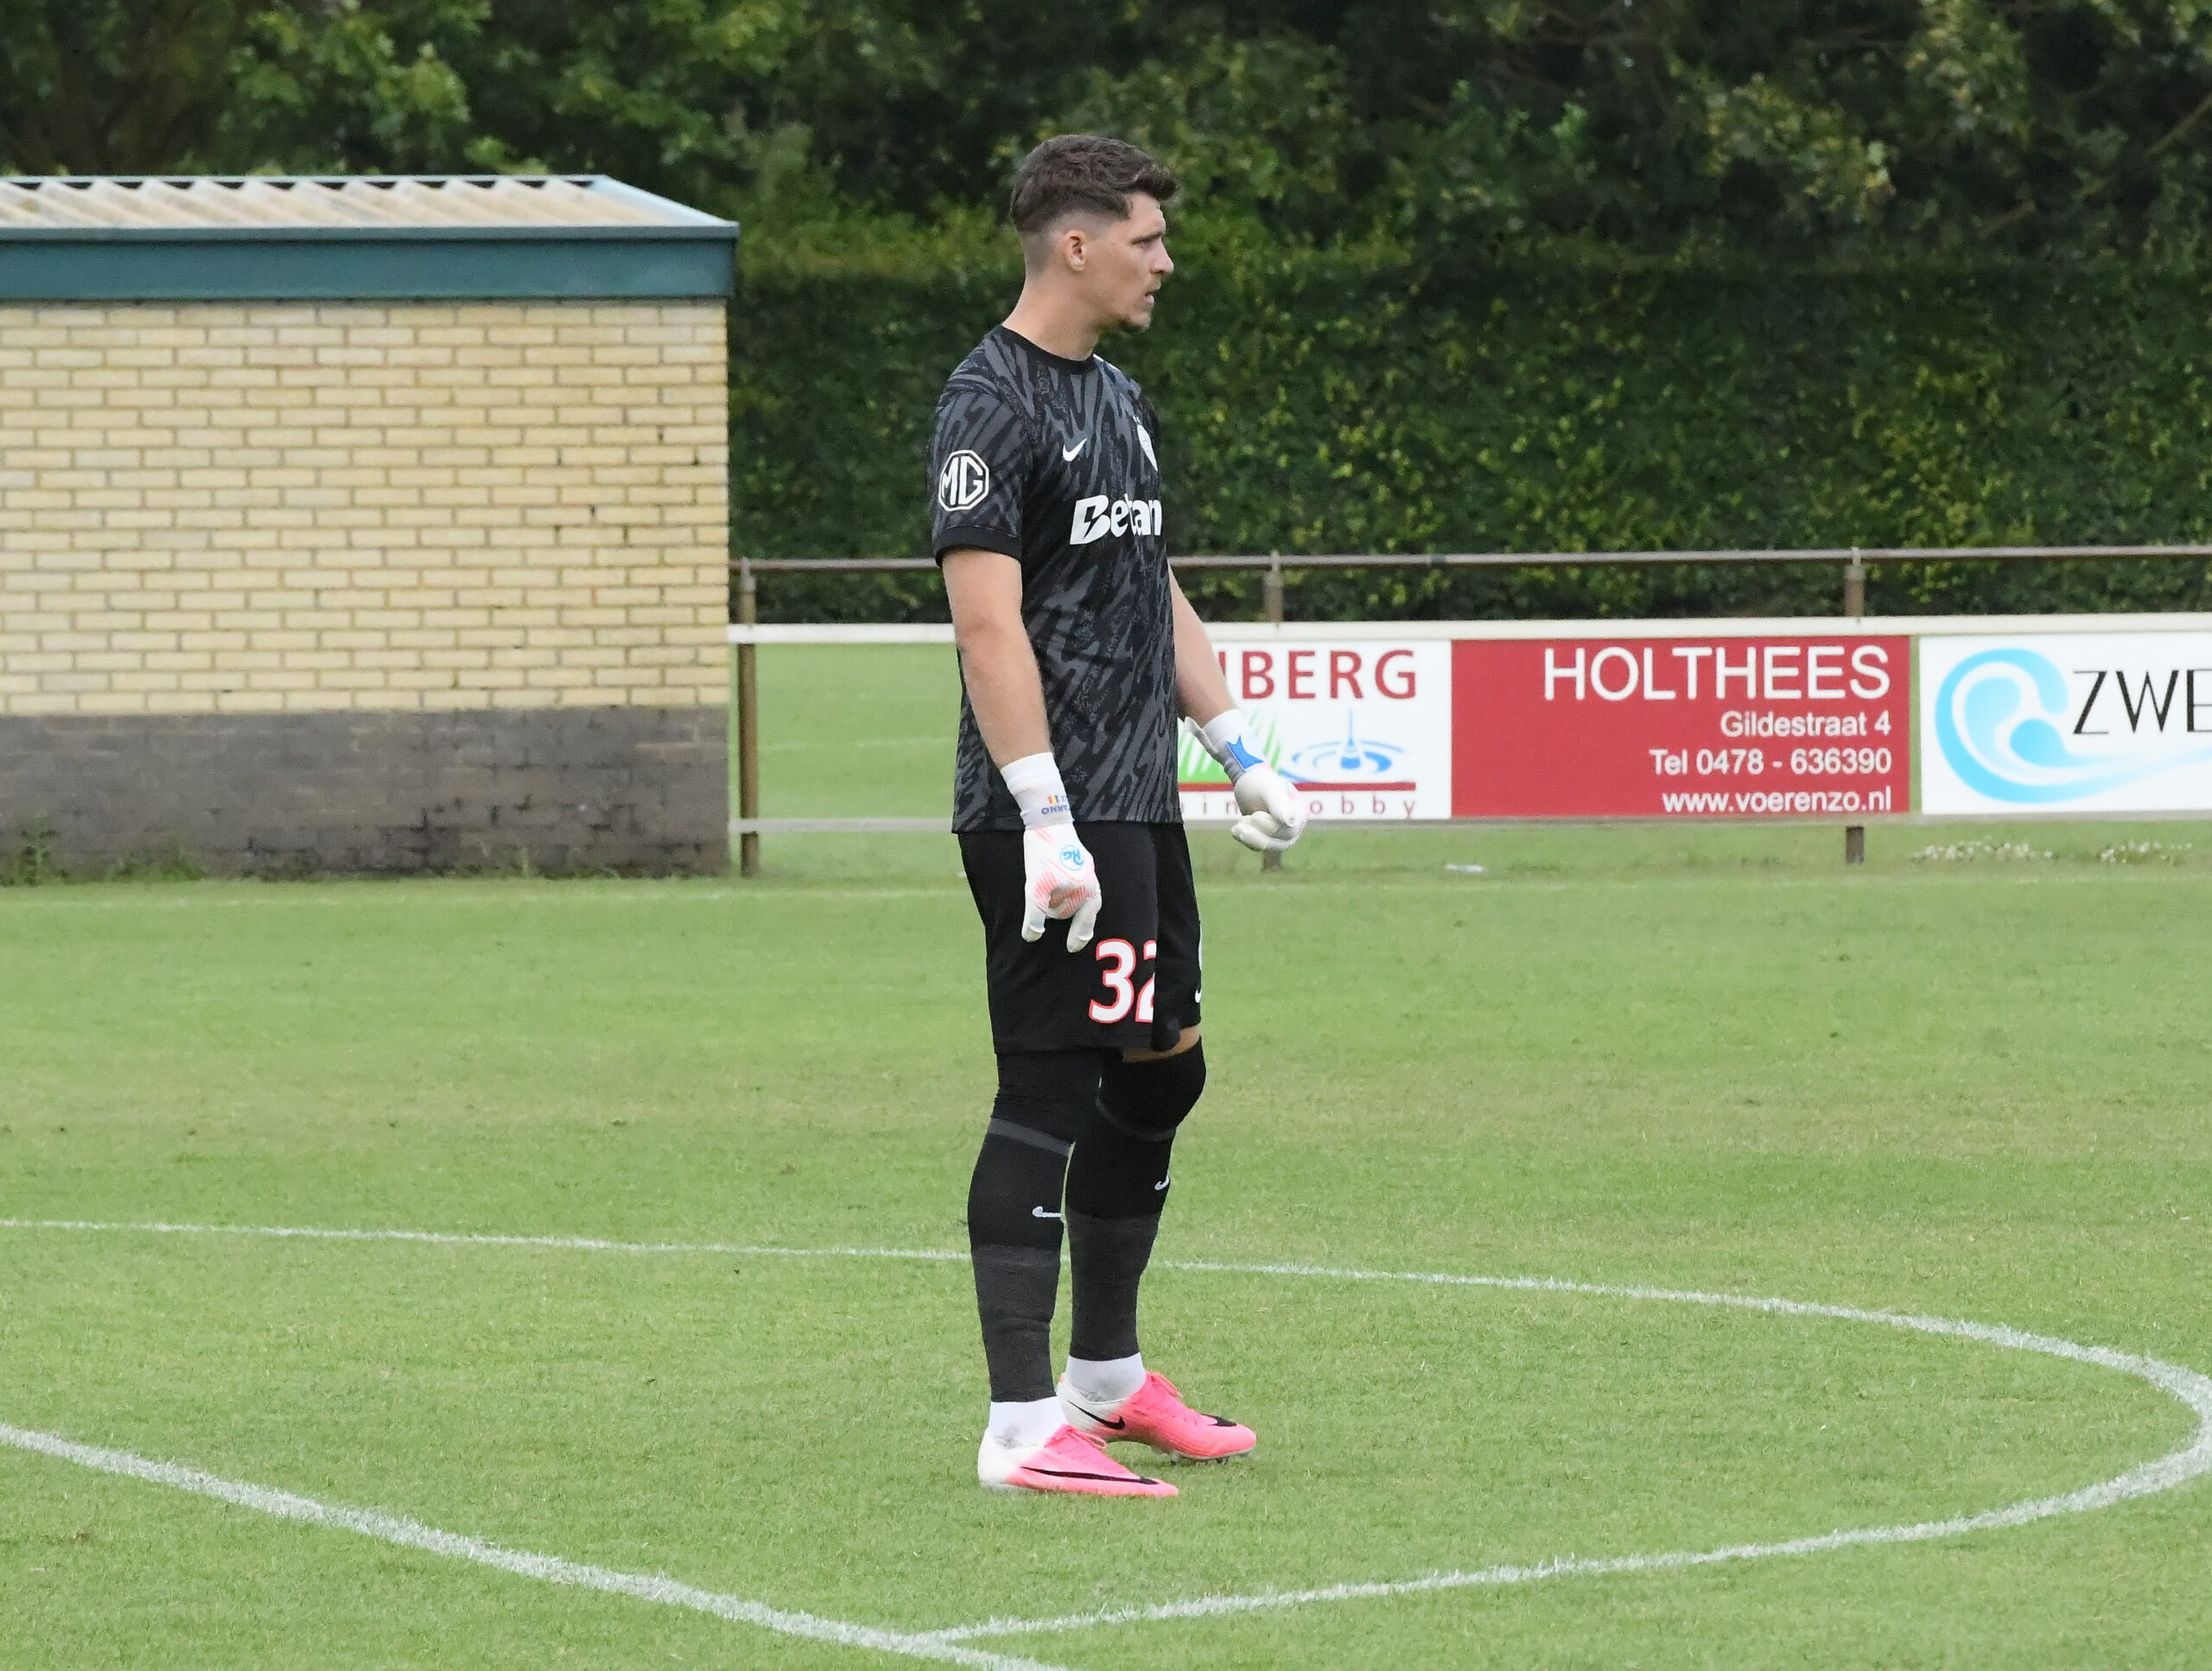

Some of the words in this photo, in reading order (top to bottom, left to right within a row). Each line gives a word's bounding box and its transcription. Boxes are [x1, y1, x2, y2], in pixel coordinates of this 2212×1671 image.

[941, 455, 984, 506] MG
[1218, 650, 1416, 700] BERG
[1544, 645, 1891, 701] HOLTHEES
[2073, 669, 2212, 734] ZWE
[1720, 710, 1867, 738] Gildestraat
[1874, 710, 1891, 736] 4
[1649, 748, 1688, 775] Tel
[1696, 748, 1764, 775] 0478
[1790, 747, 1891, 775] 636390
[1309, 795, 1416, 819] obby
[1662, 785, 1891, 813] www.voerenzo.nl
